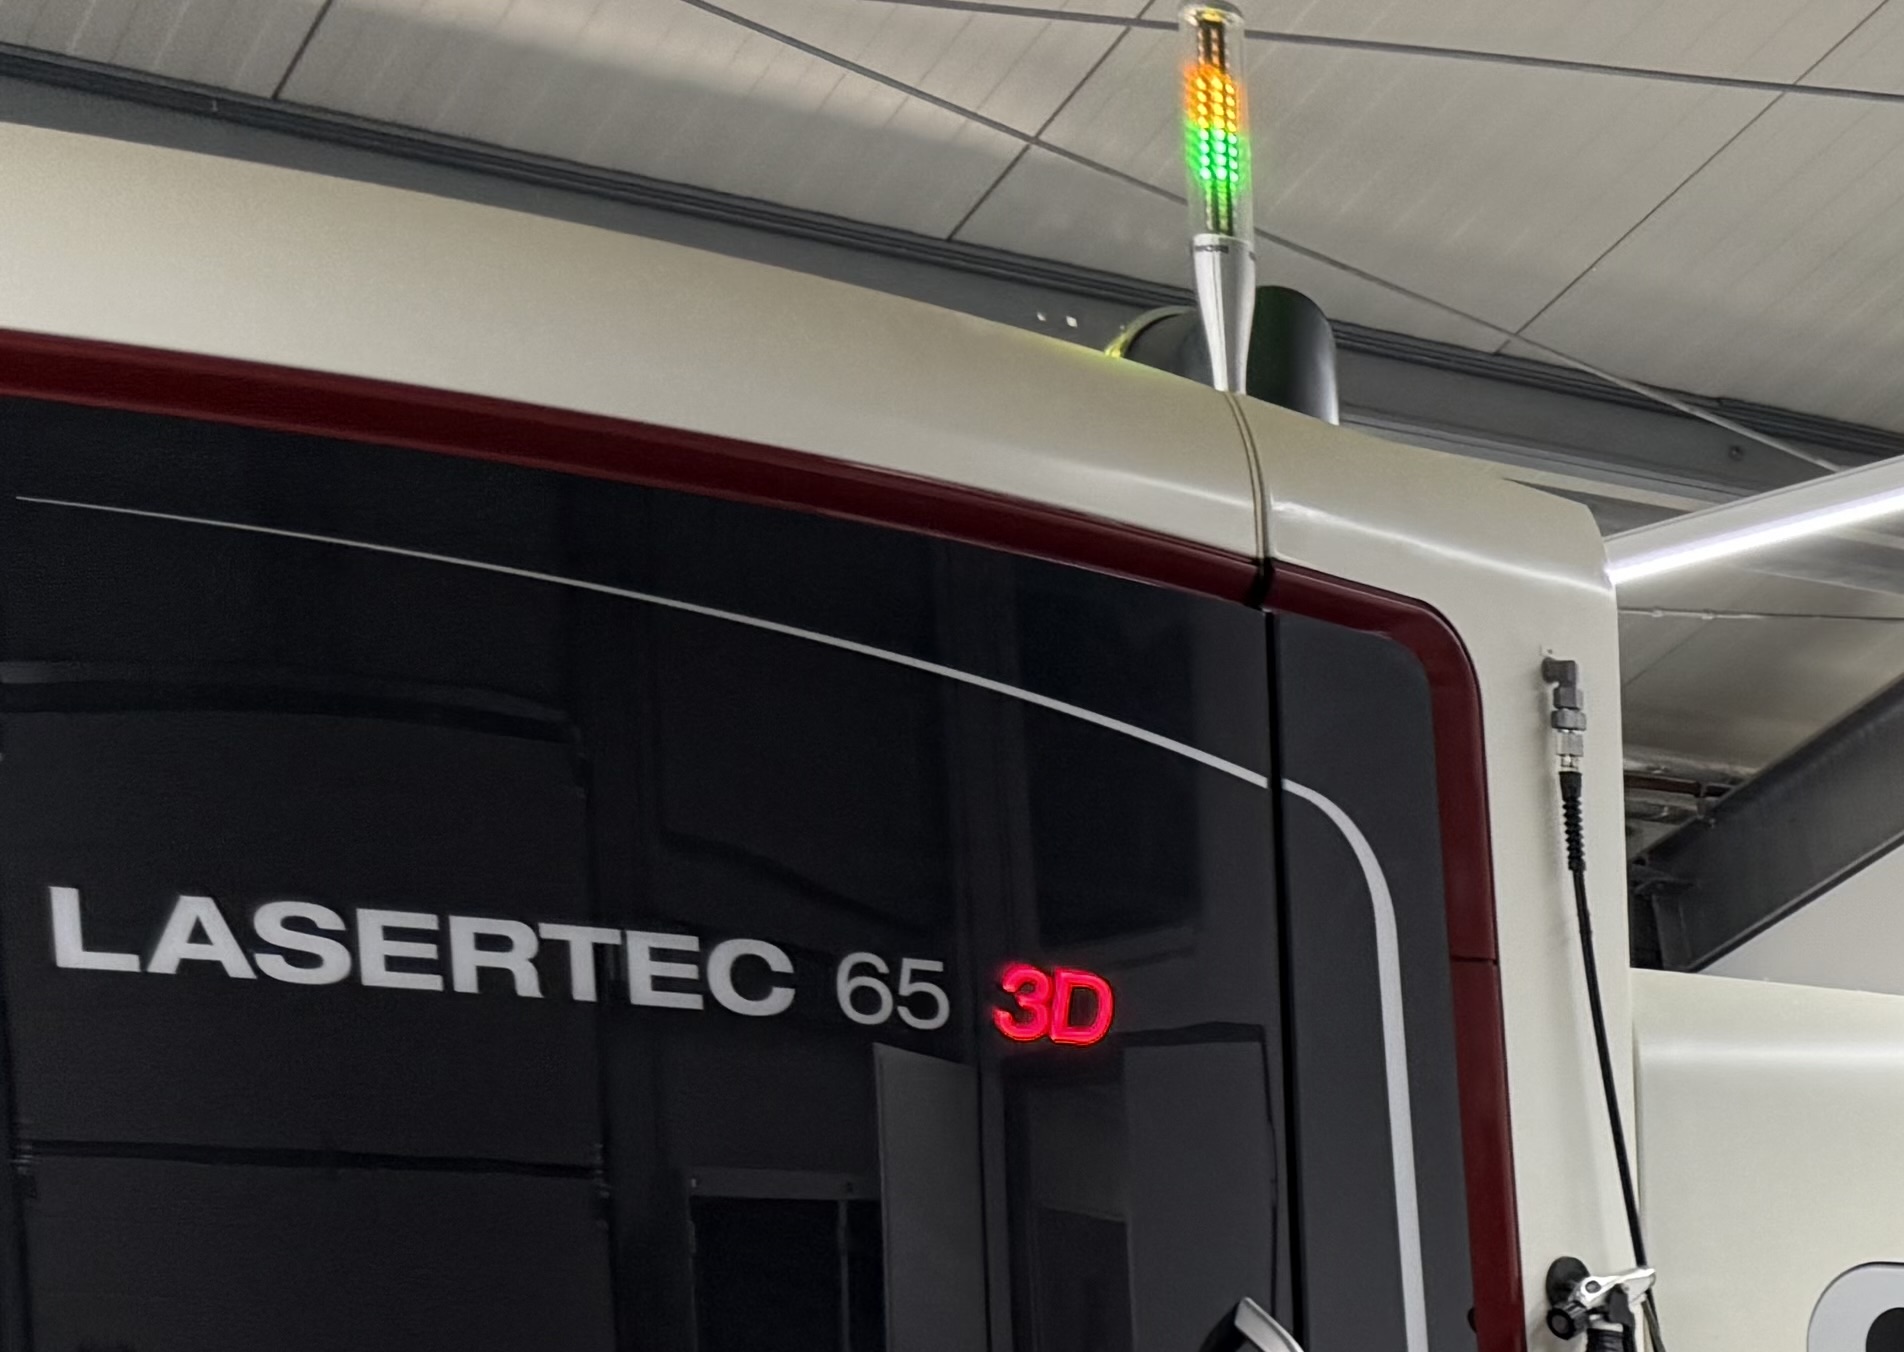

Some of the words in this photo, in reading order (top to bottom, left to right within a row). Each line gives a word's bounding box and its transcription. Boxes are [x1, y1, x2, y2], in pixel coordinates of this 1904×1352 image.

[48, 885, 796, 1017] LASERTEC
[836, 951, 951, 1030] 65
[993, 962, 1116, 1046] 3D
